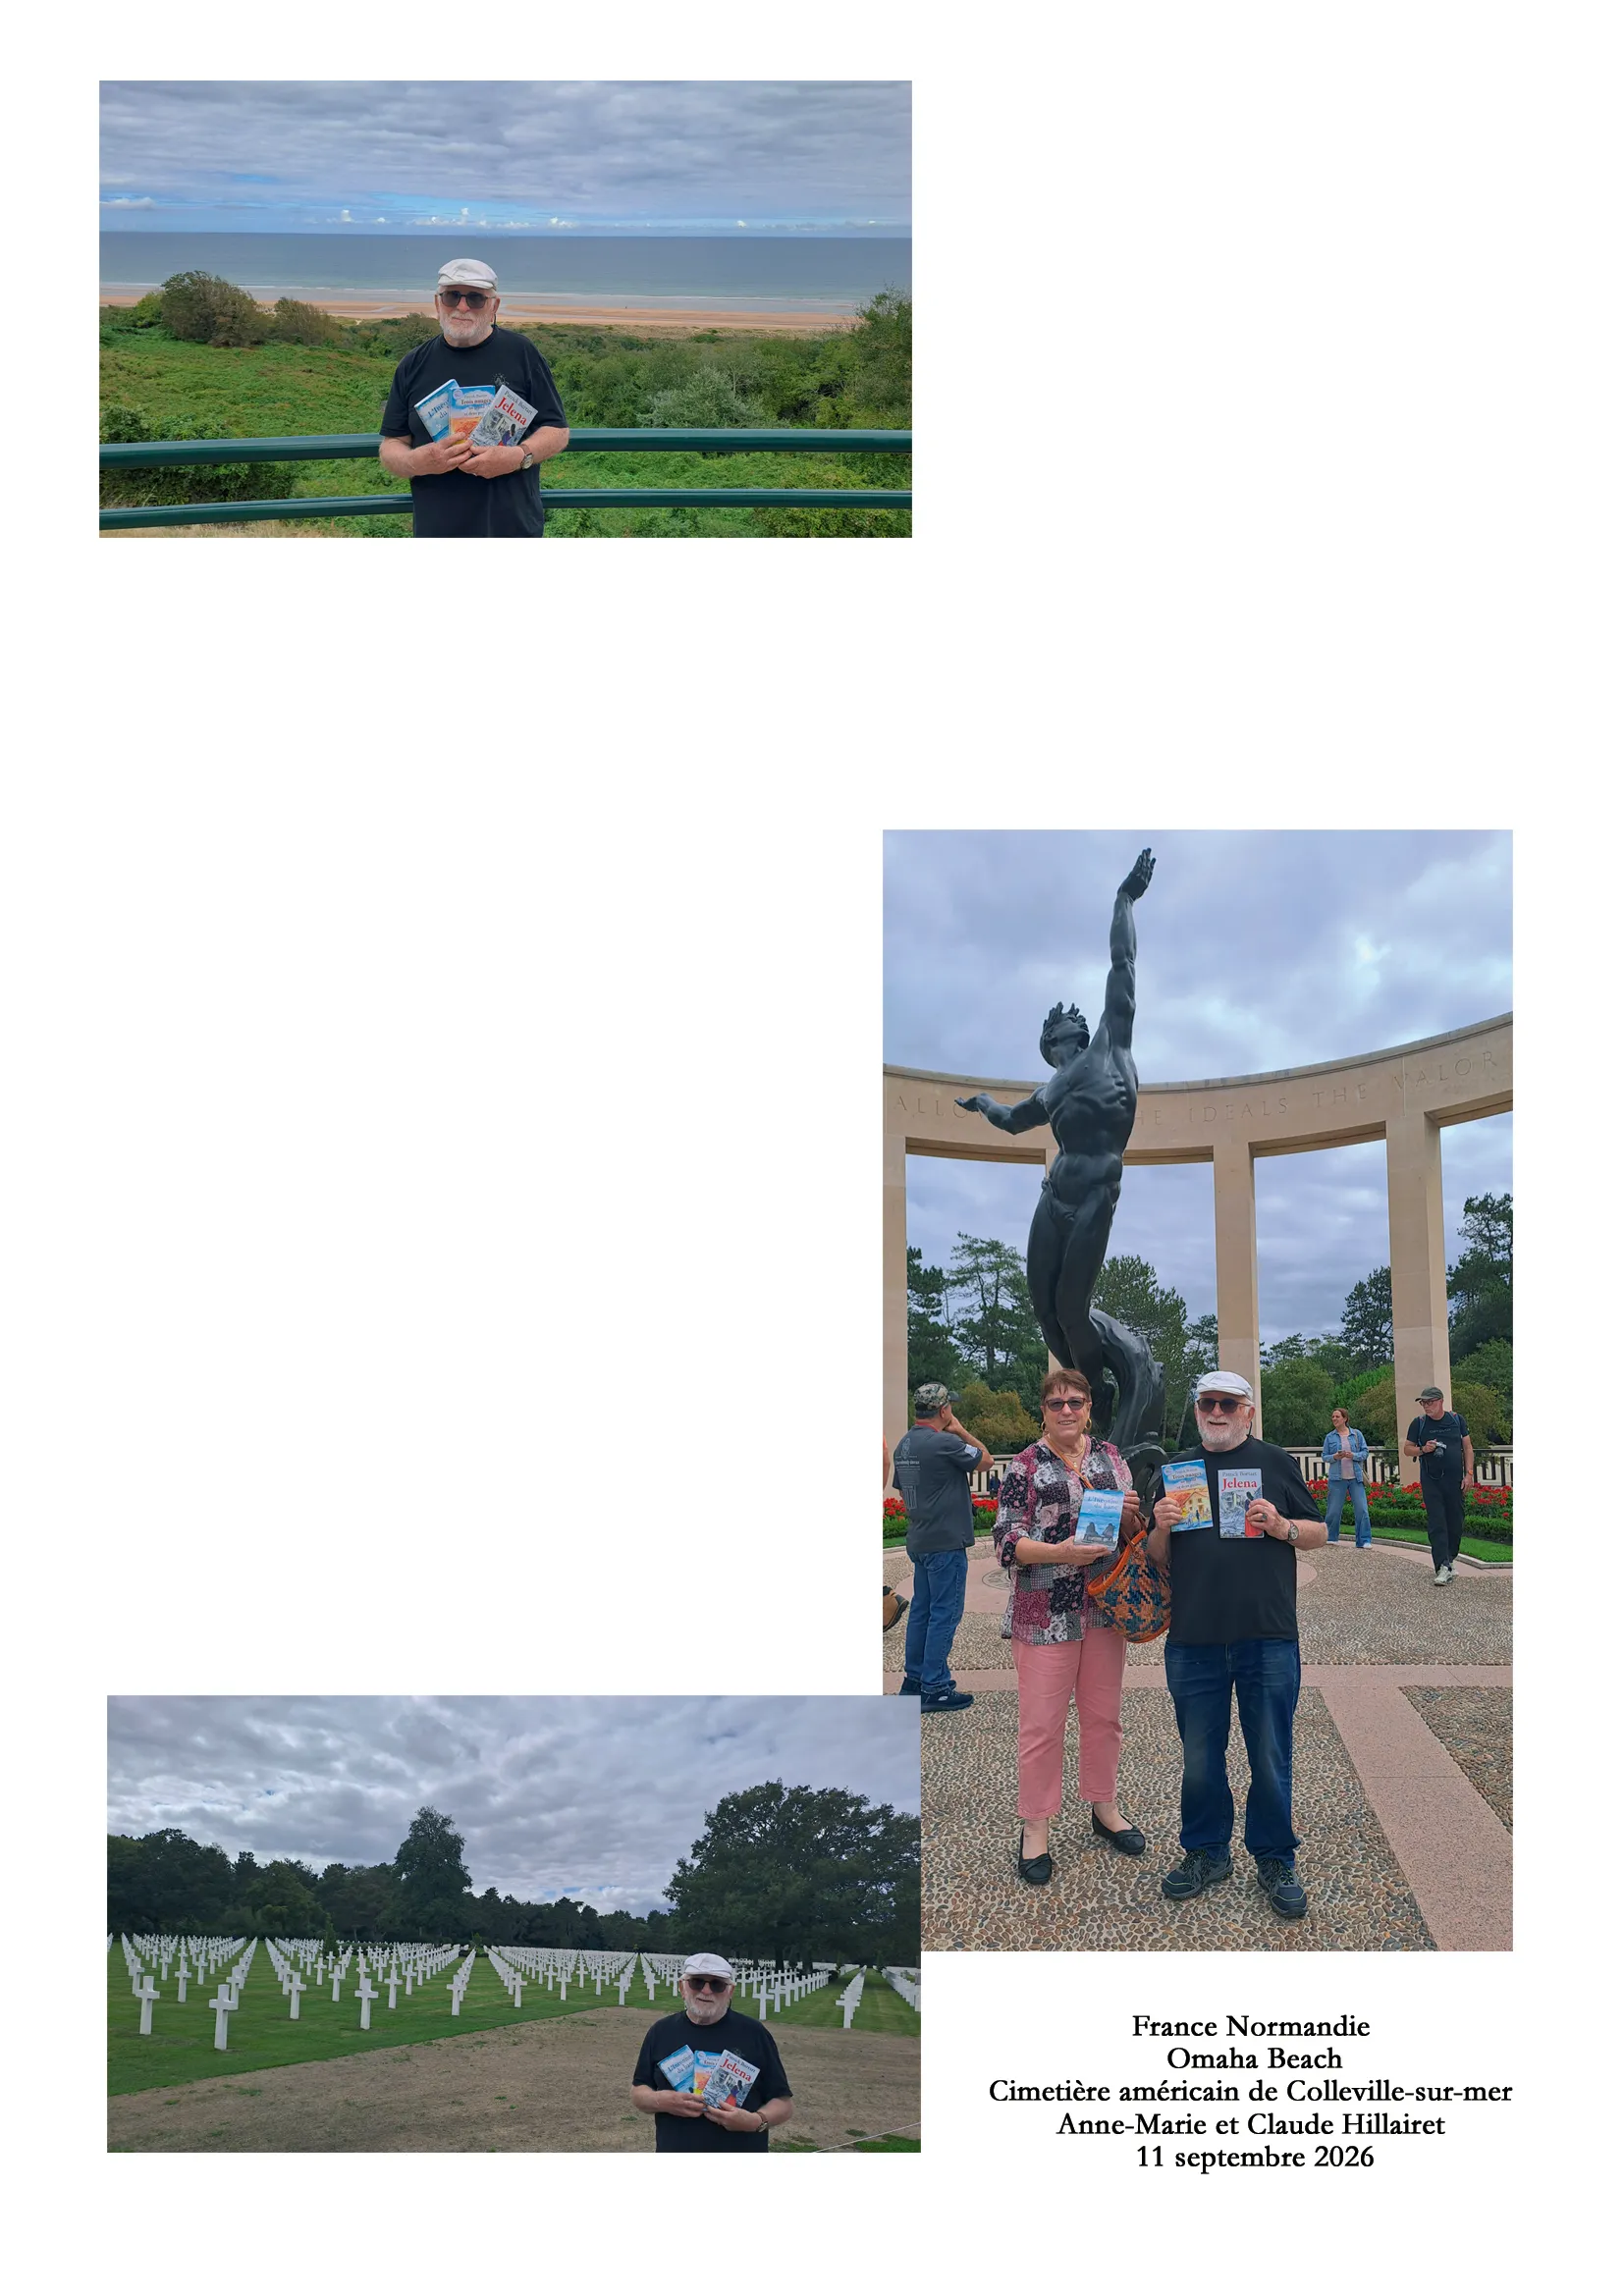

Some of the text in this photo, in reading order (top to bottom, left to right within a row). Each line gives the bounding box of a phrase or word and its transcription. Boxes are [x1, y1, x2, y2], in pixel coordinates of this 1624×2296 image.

[494, 397, 528, 426] Jelena
[1313, 1050, 1497, 1107] THE VALOR
[1189, 1096, 1288, 1124] IDEALS
[1221, 1477, 1257, 1491] Jelena
[720, 2058, 752, 2082] Jelena
